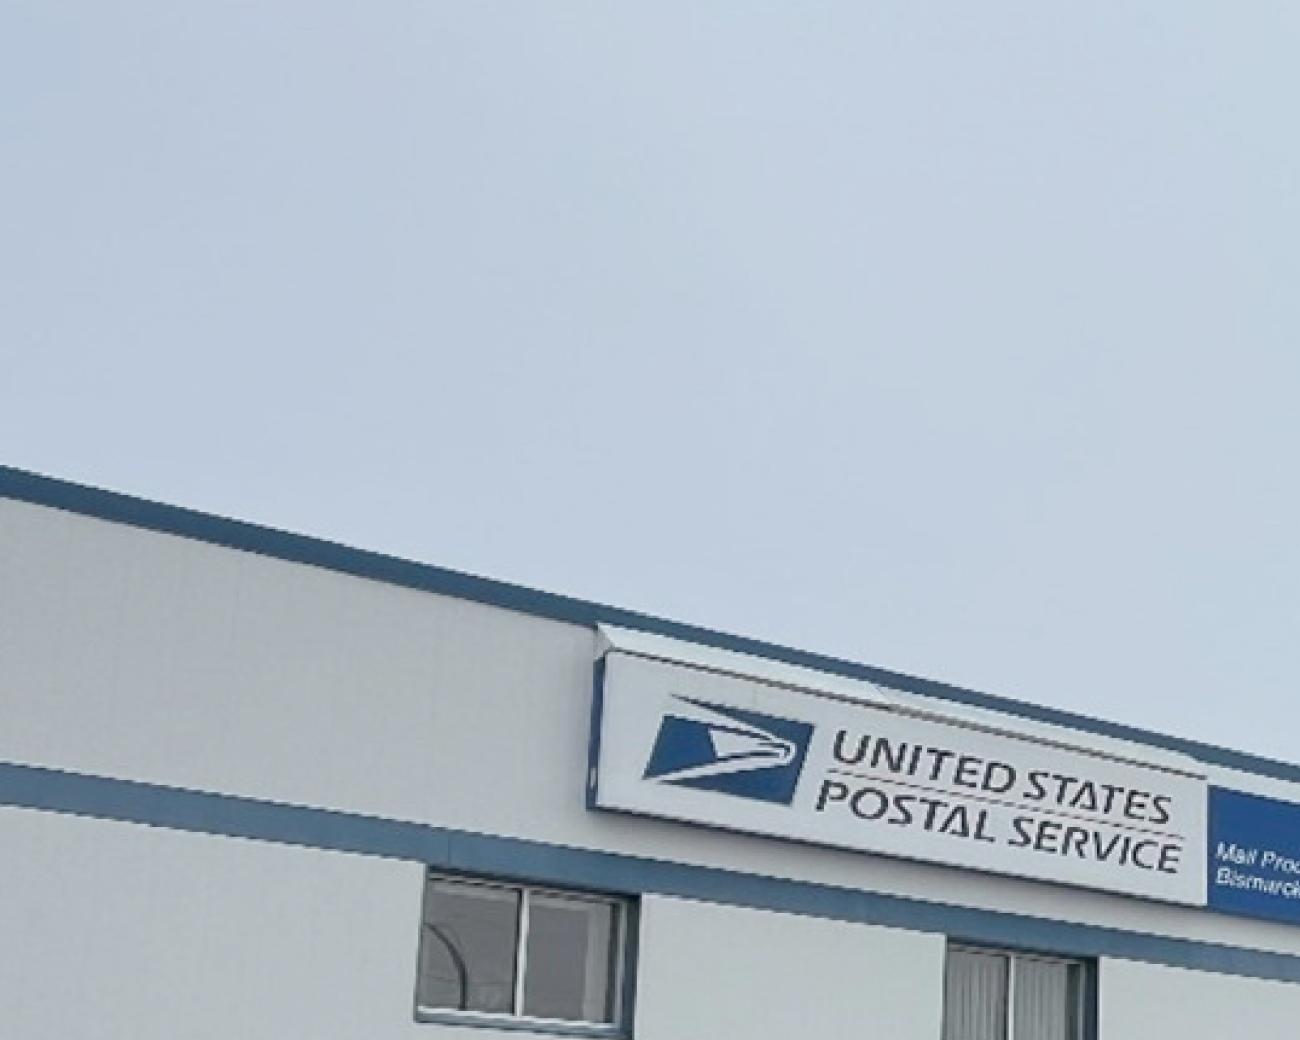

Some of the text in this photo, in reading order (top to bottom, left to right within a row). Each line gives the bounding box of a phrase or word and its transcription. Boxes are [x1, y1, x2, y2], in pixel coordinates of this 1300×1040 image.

[832, 729, 1173, 825] UNITED STATES
[815, 779, 1183, 874] POSTAL SERVICE
[1216, 842, 1257, 866] Mail
